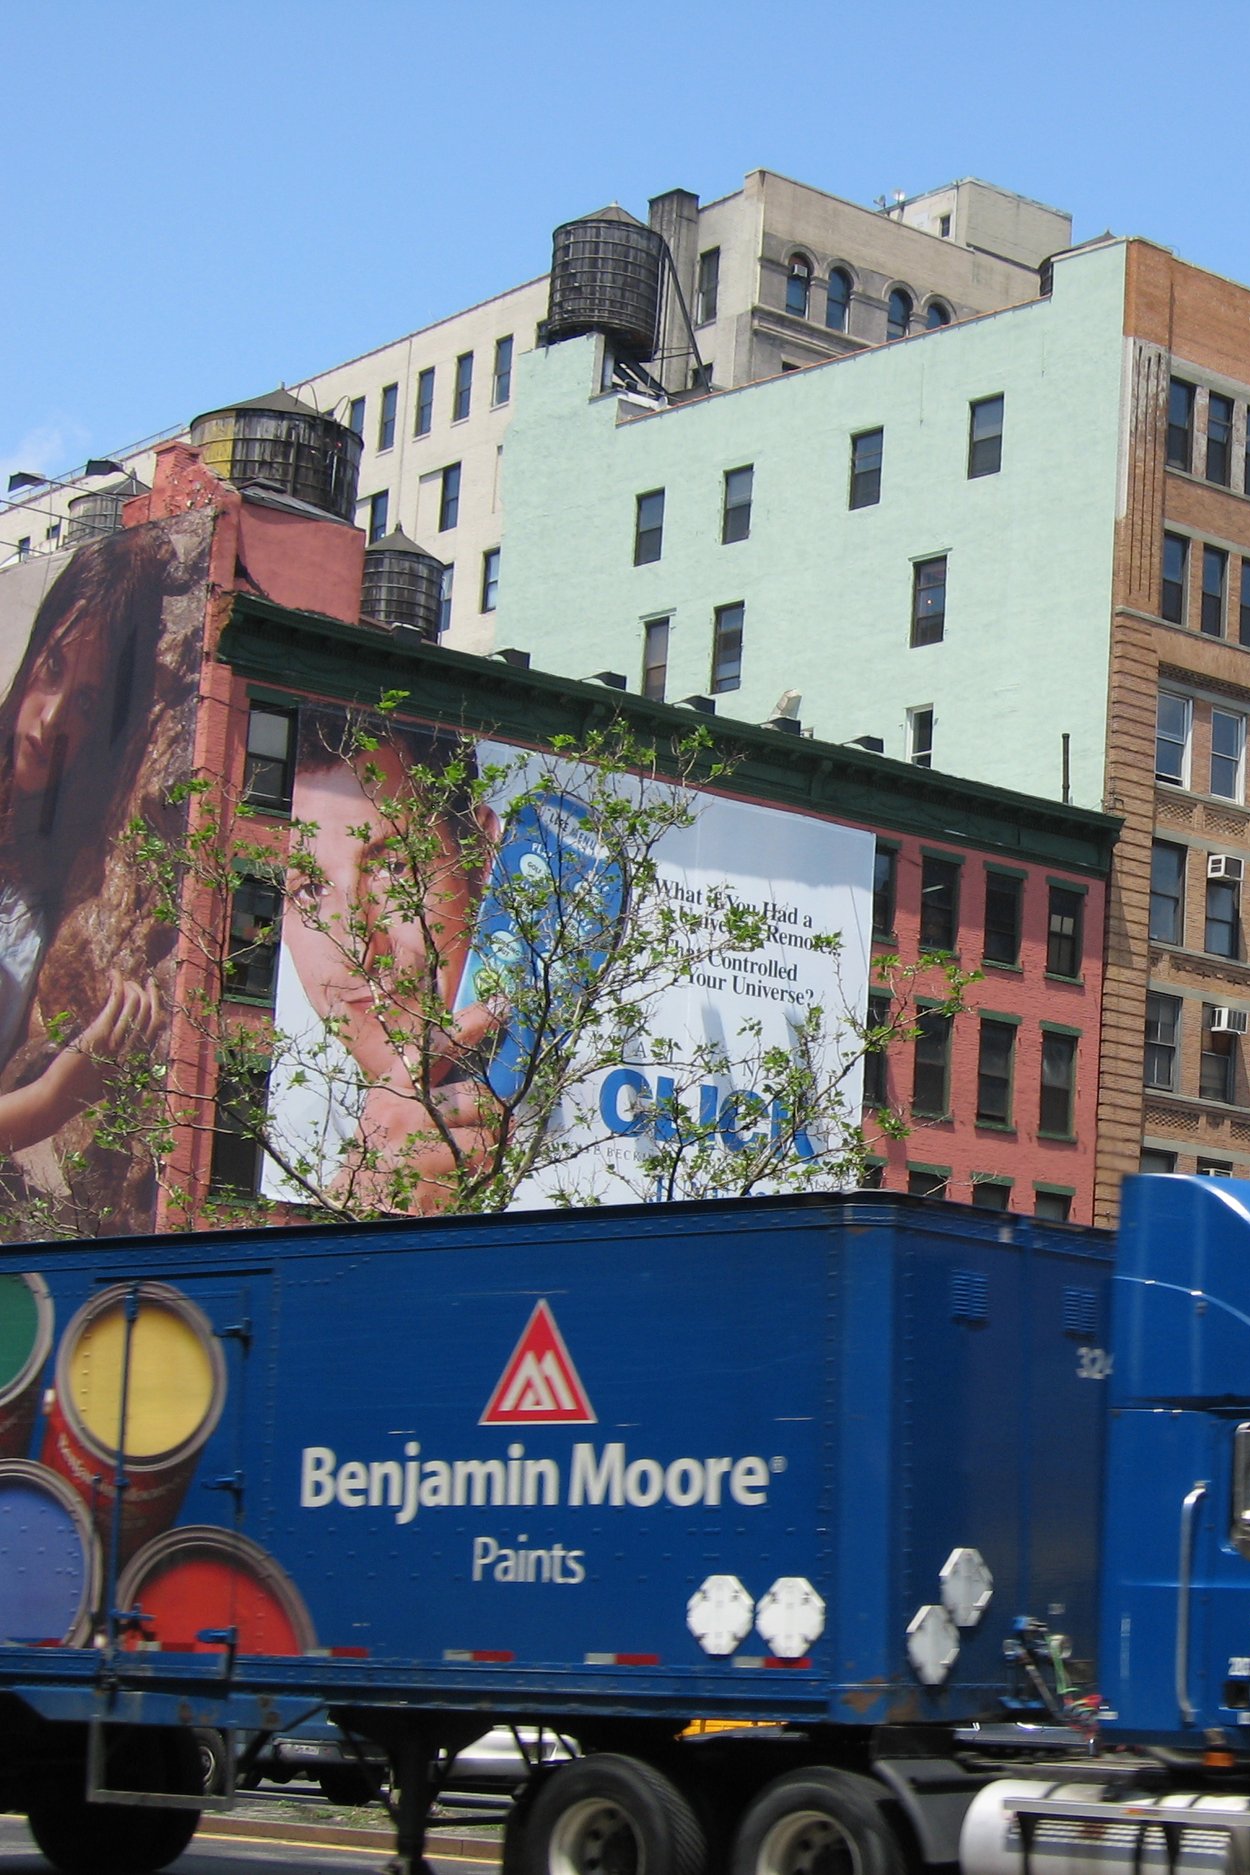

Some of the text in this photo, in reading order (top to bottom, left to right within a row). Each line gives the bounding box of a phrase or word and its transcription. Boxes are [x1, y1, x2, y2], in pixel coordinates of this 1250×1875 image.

[655, 878, 702, 905] What
[763, 901, 798, 925] Had
[803, 914, 813, 928] a
[767, 925, 841, 957] Remoe...
[688, 967, 814, 1007] Your Universe?
[709, 954, 797, 981] Controlled
[301, 1441, 559, 1525] Benjamin
[472, 1534, 585, 1584] Paints
